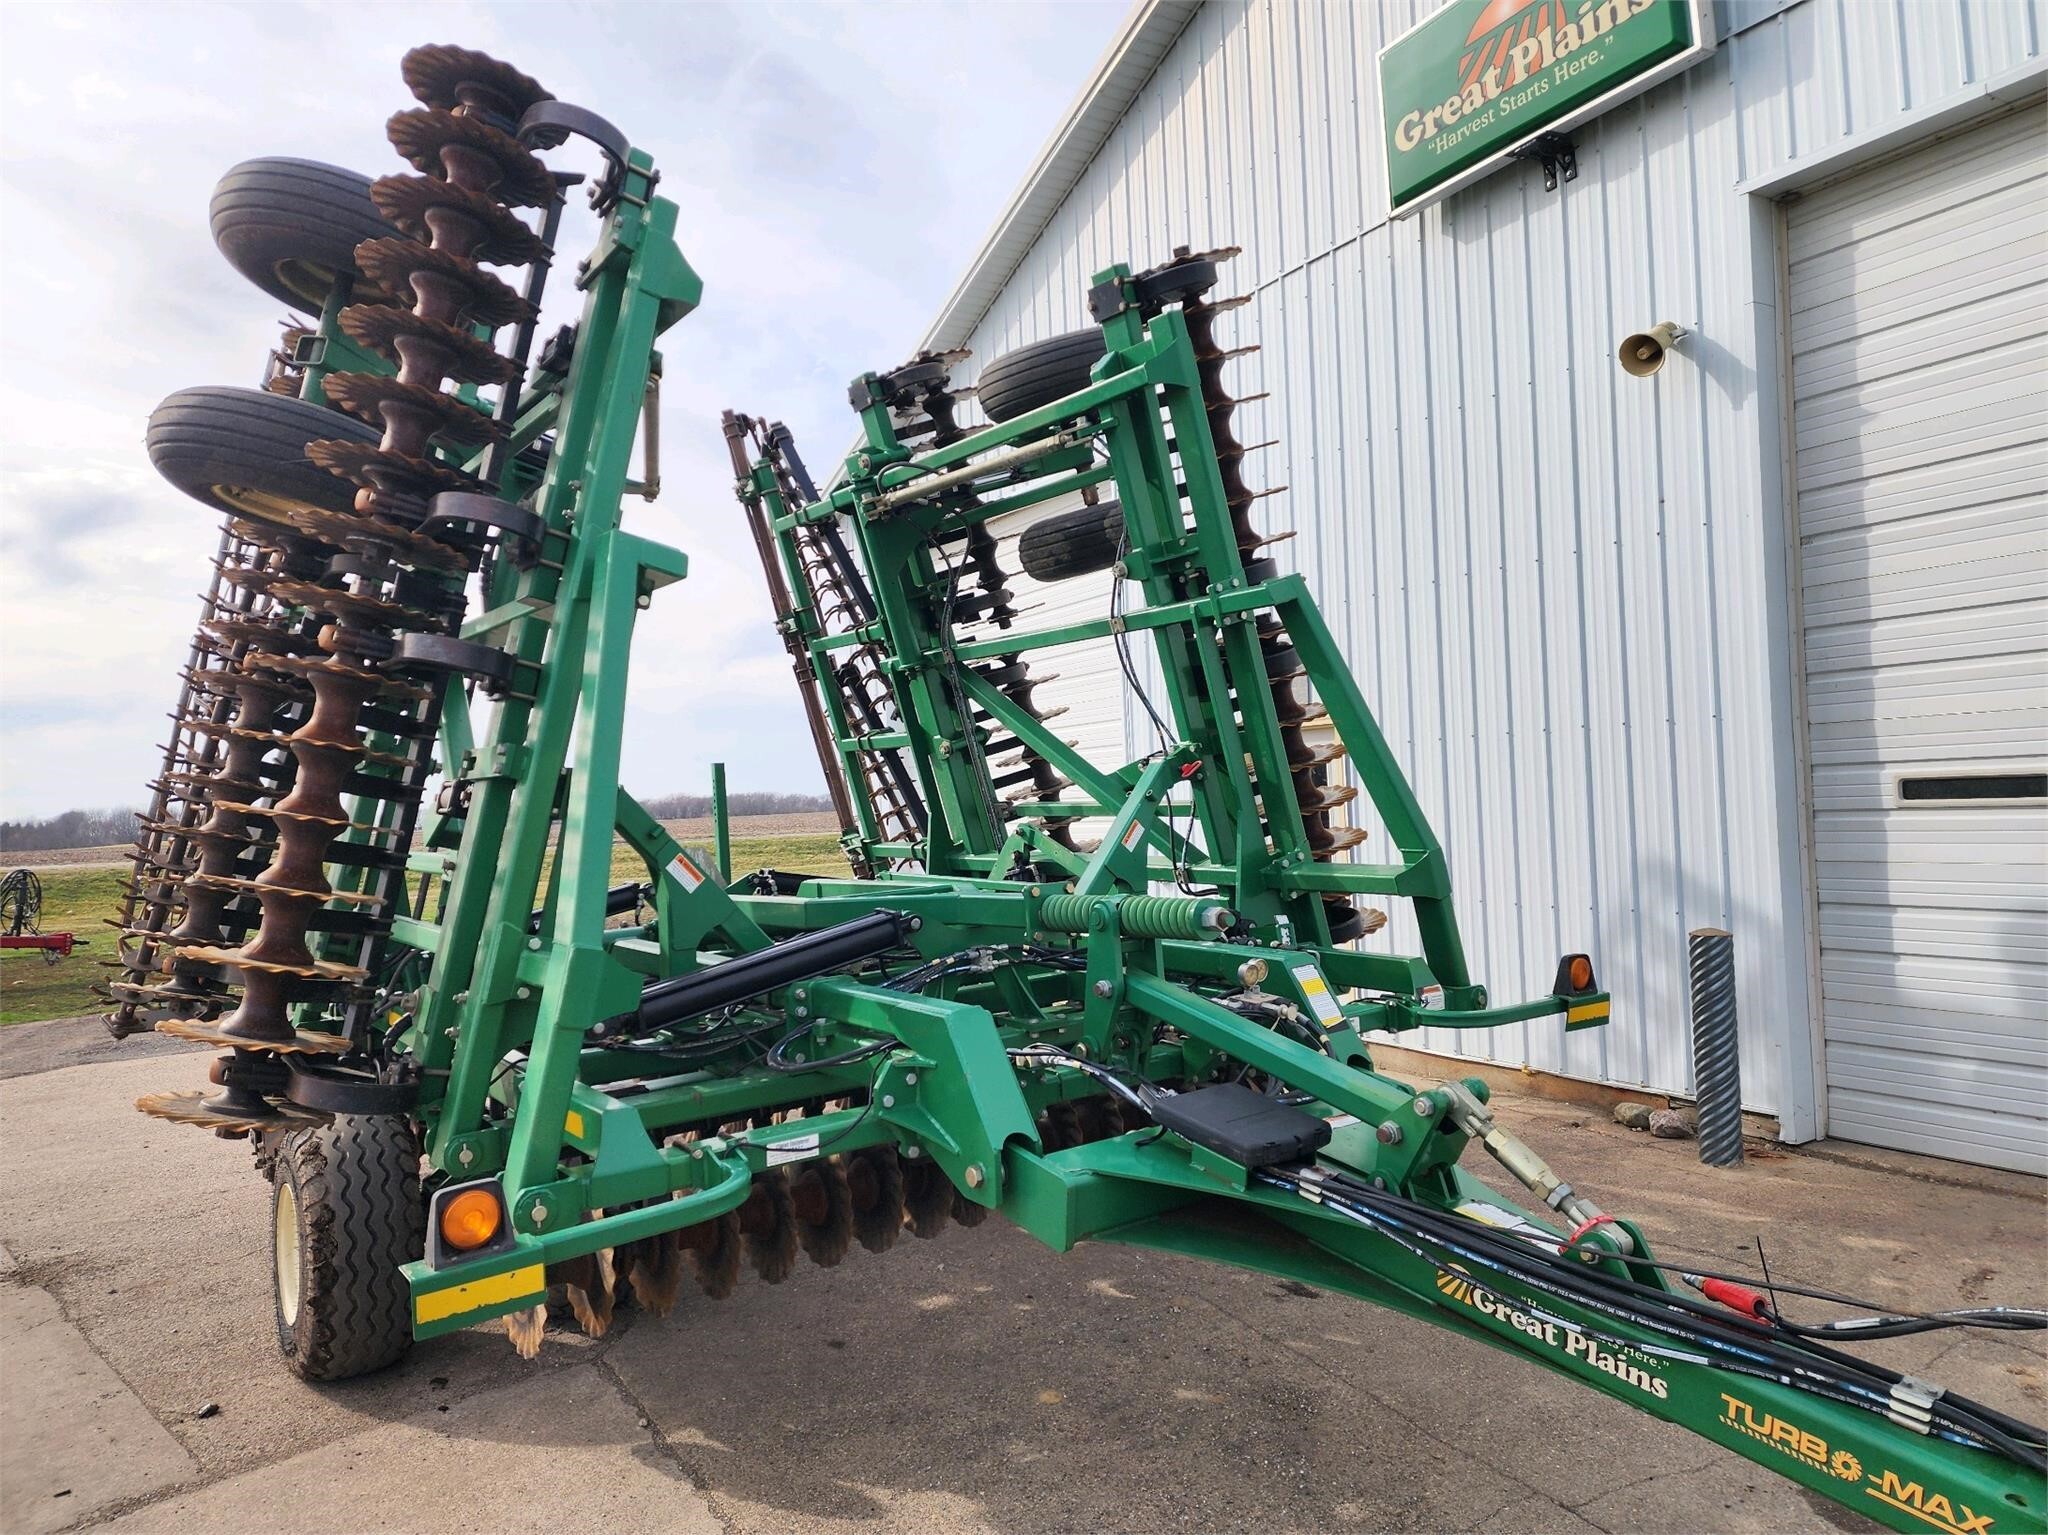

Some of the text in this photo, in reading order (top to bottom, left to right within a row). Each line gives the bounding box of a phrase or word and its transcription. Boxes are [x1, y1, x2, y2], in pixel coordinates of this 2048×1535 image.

[1394, 64, 1503, 152] Great
[1500, 78, 1549, 116] Starts
[1471, 1285, 1558, 1346] Great
[1565, 1329, 1668, 1399] Plains
